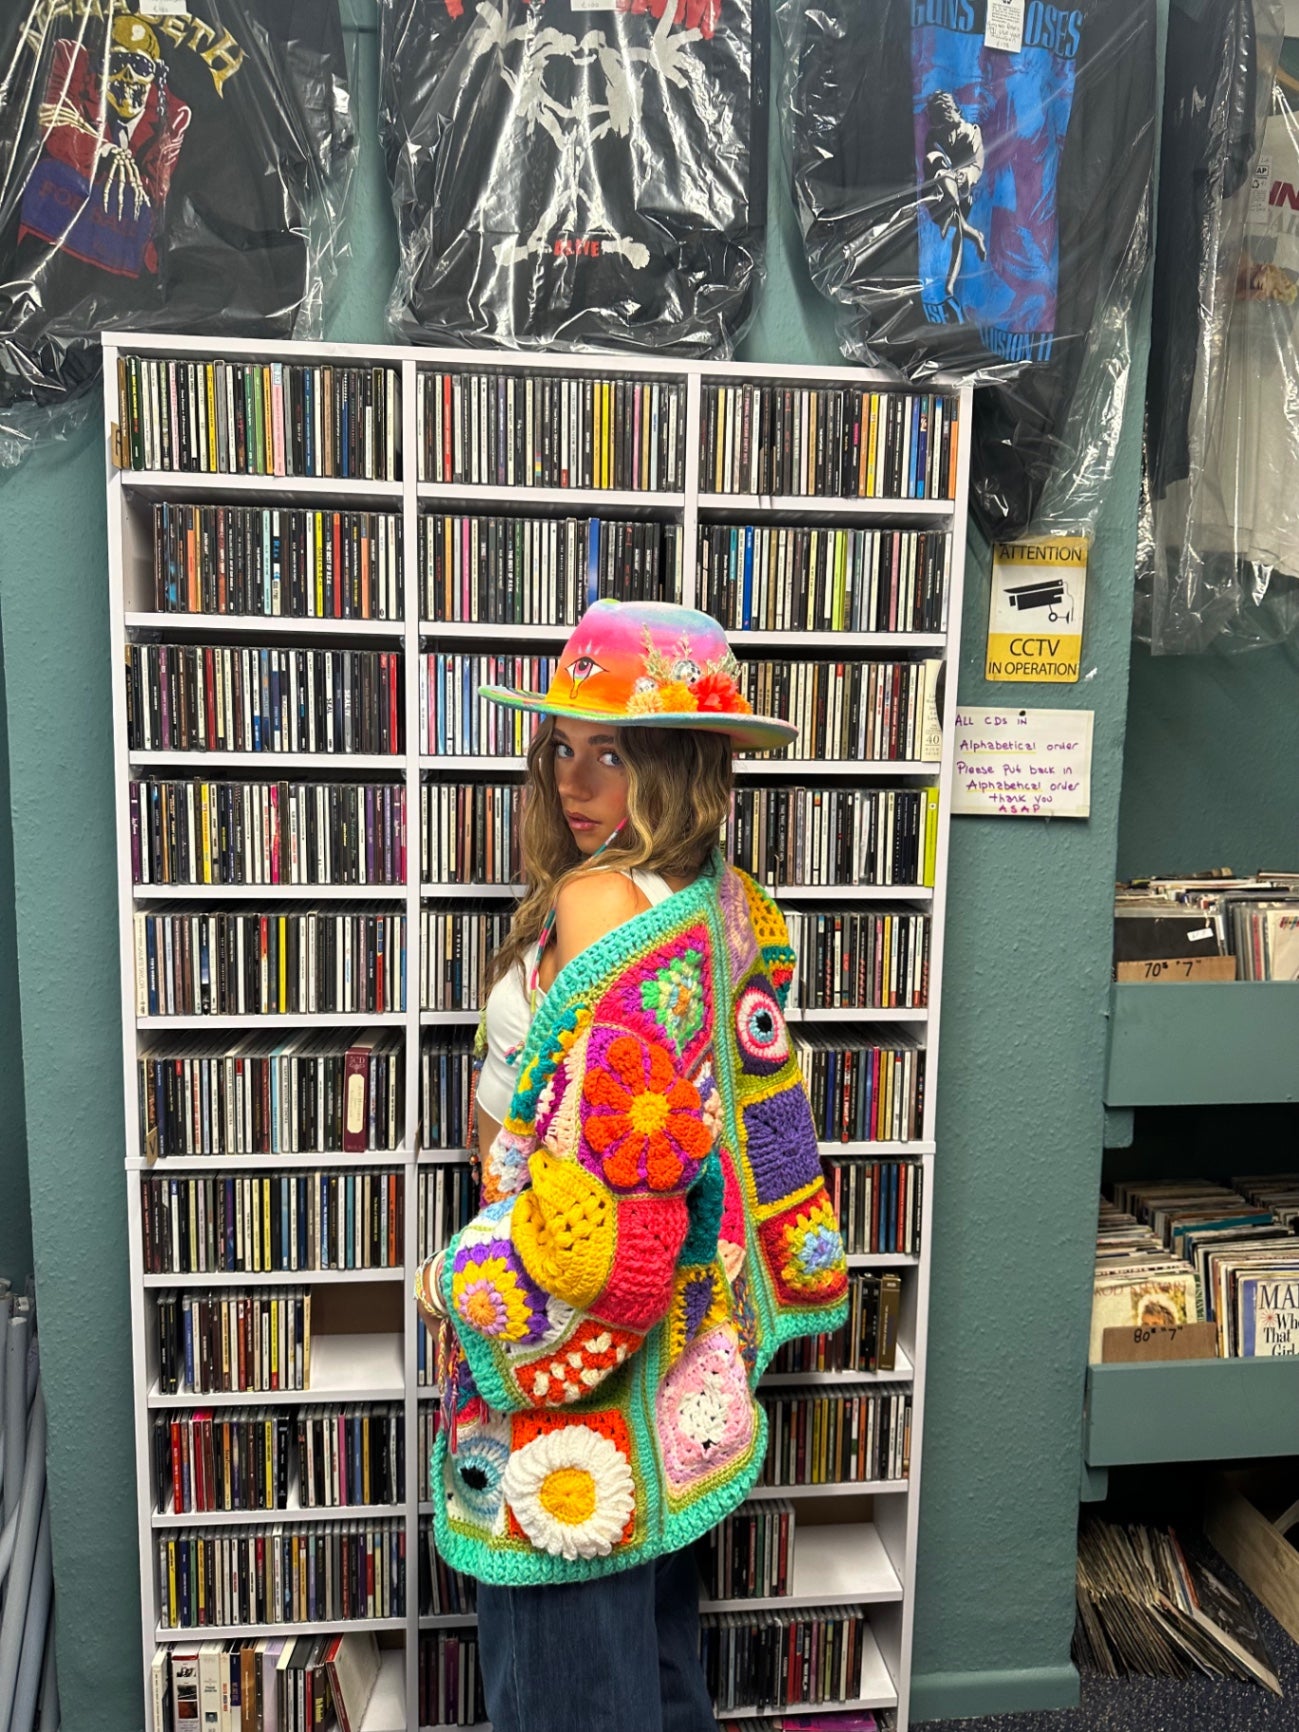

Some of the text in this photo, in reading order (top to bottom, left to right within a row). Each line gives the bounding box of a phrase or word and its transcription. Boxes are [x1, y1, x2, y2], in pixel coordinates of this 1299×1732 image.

[1025, 0, 1083, 57] OSES
[999, 545, 1082, 562] ATTENTION
[1010, 638, 1061, 657] CCTV
[988, 661, 1077, 676] IN OPERATION
[955, 714, 974, 726] ALL
[960, 740, 1079, 753] Alphabetical order
[956, 761, 995, 775] Please
[1029, 765, 1056, 775] back
[1063, 767, 1073, 775] in
[1050, 781, 1081, 791] order
[989, 793, 1053, 803] thank you
[1258, 1284, 1299, 1310] MA
[1275, 1313, 1299, 1330] Wh
[1263, 1327, 1291, 1344] That
